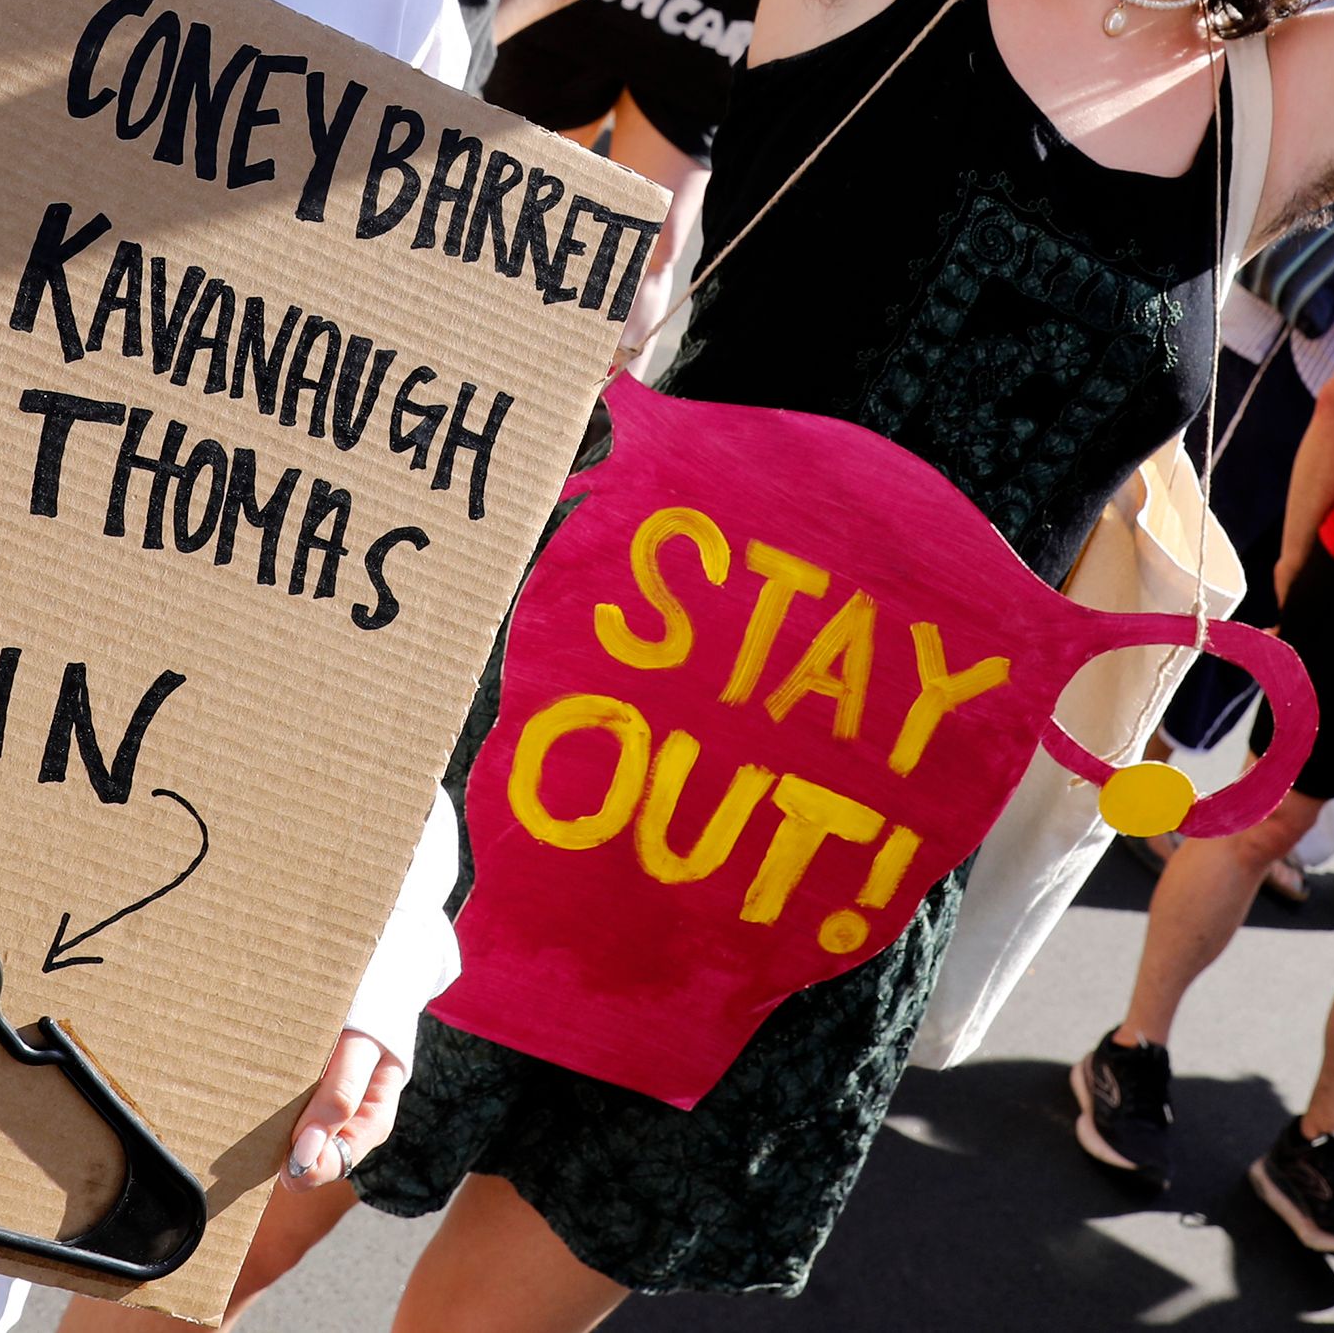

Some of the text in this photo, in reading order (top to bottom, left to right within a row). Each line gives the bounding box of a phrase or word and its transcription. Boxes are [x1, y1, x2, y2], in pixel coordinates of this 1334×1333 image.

[355, 104, 665, 323] BARRETT
[8, 202, 515, 521] KAVANAUGH
[18, 388, 431, 631] THOMAS
[593, 506, 1011, 777] STAY
[507, 693, 923, 955] OUT!
